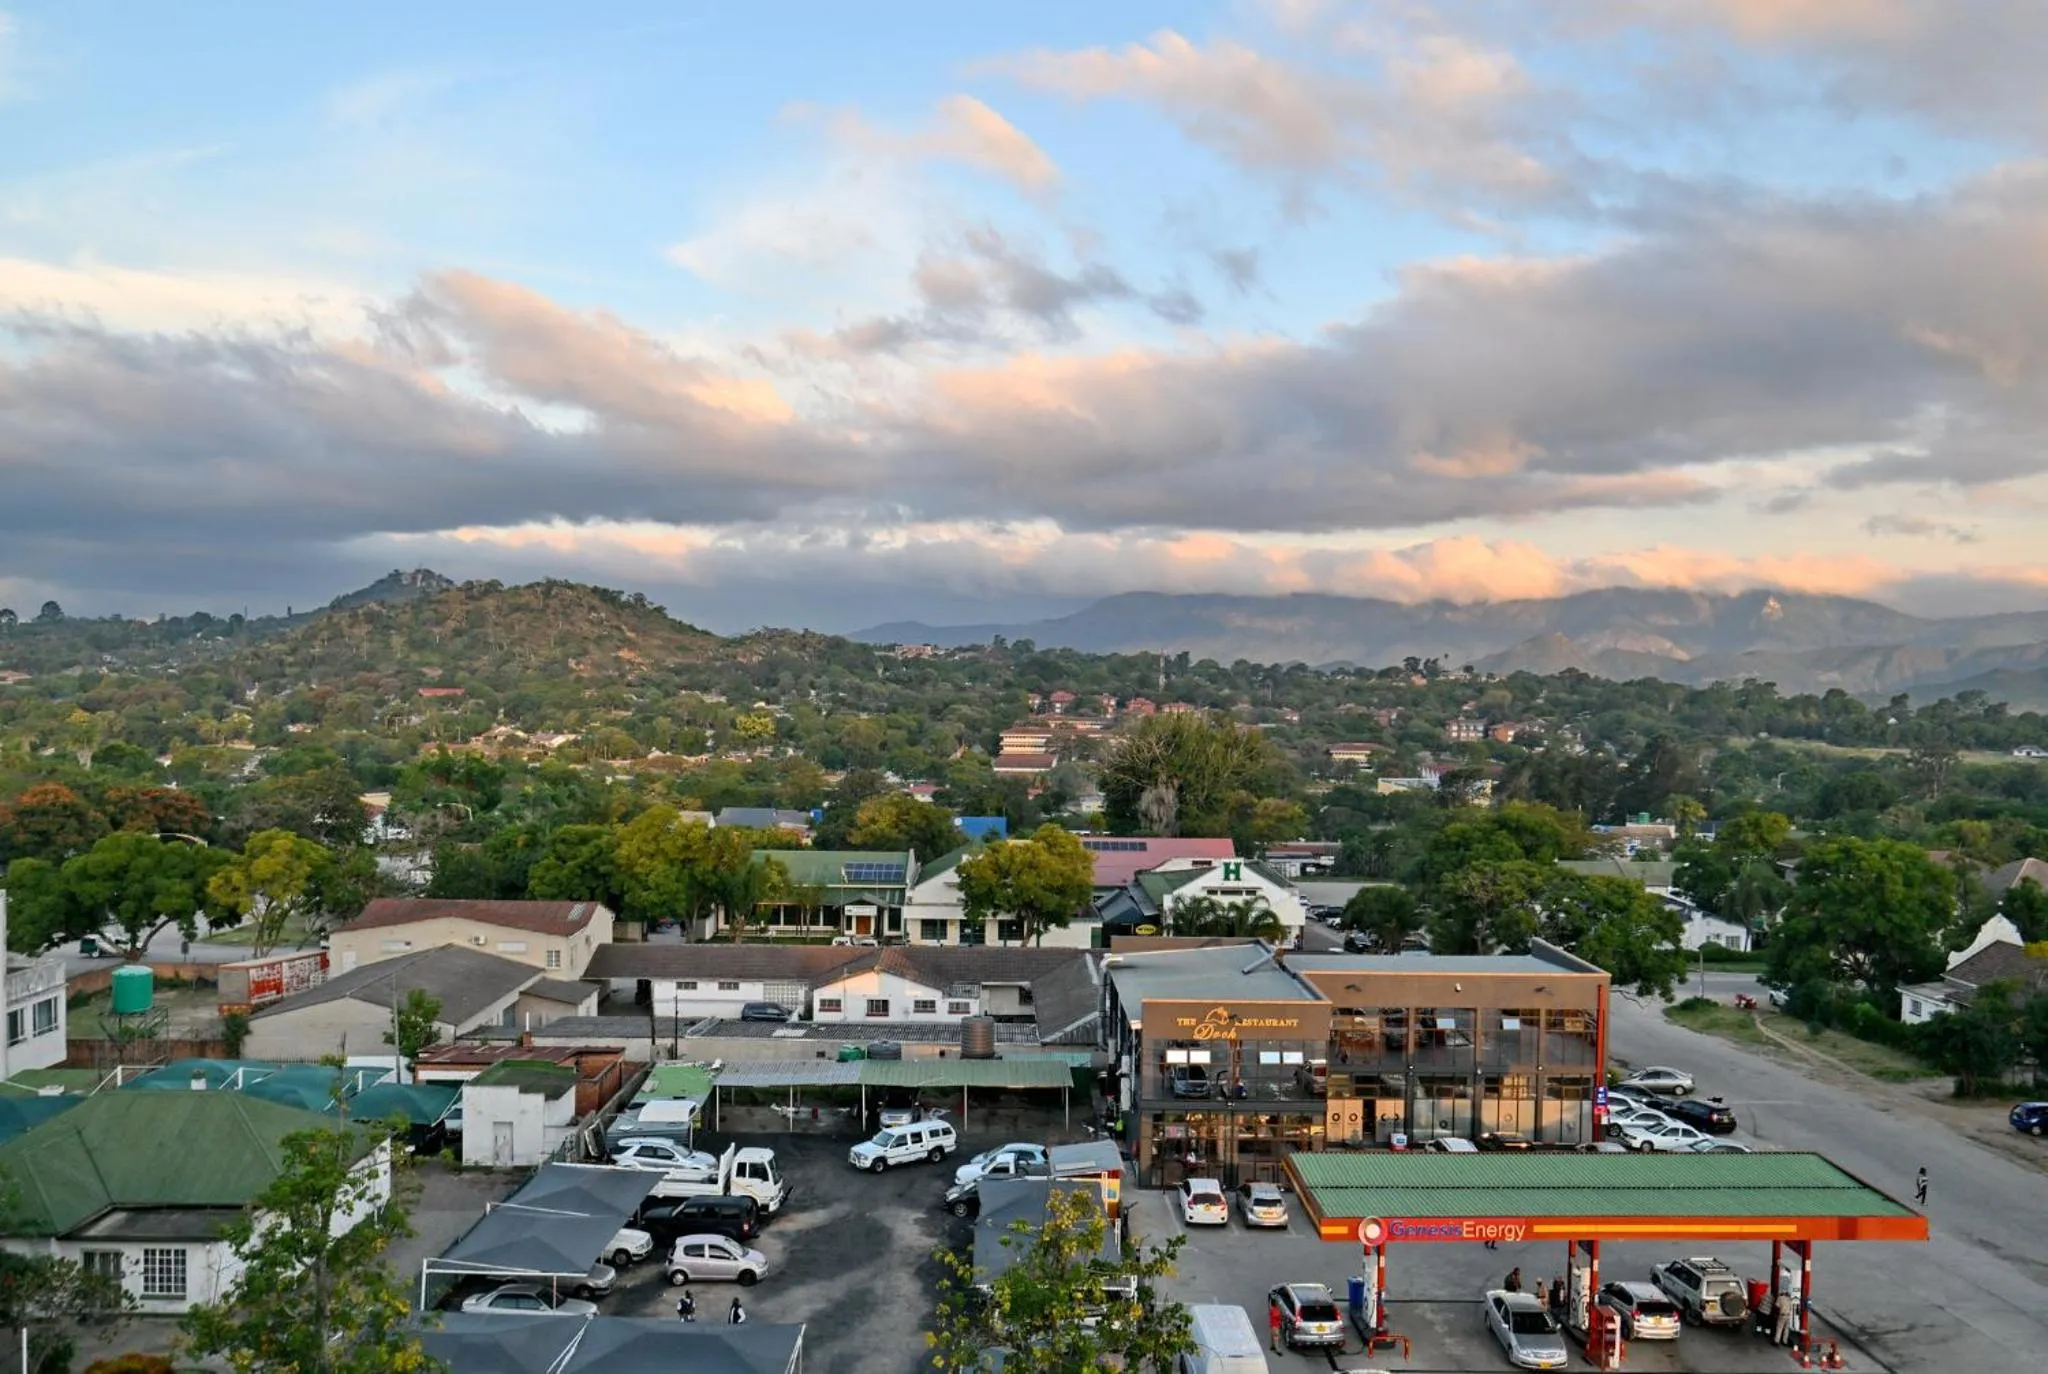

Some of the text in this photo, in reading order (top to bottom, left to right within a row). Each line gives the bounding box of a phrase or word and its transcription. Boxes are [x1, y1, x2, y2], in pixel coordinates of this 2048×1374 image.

[1223, 862, 1242, 882] H
[1176, 1017, 1299, 1027] THE ESTAURANT
